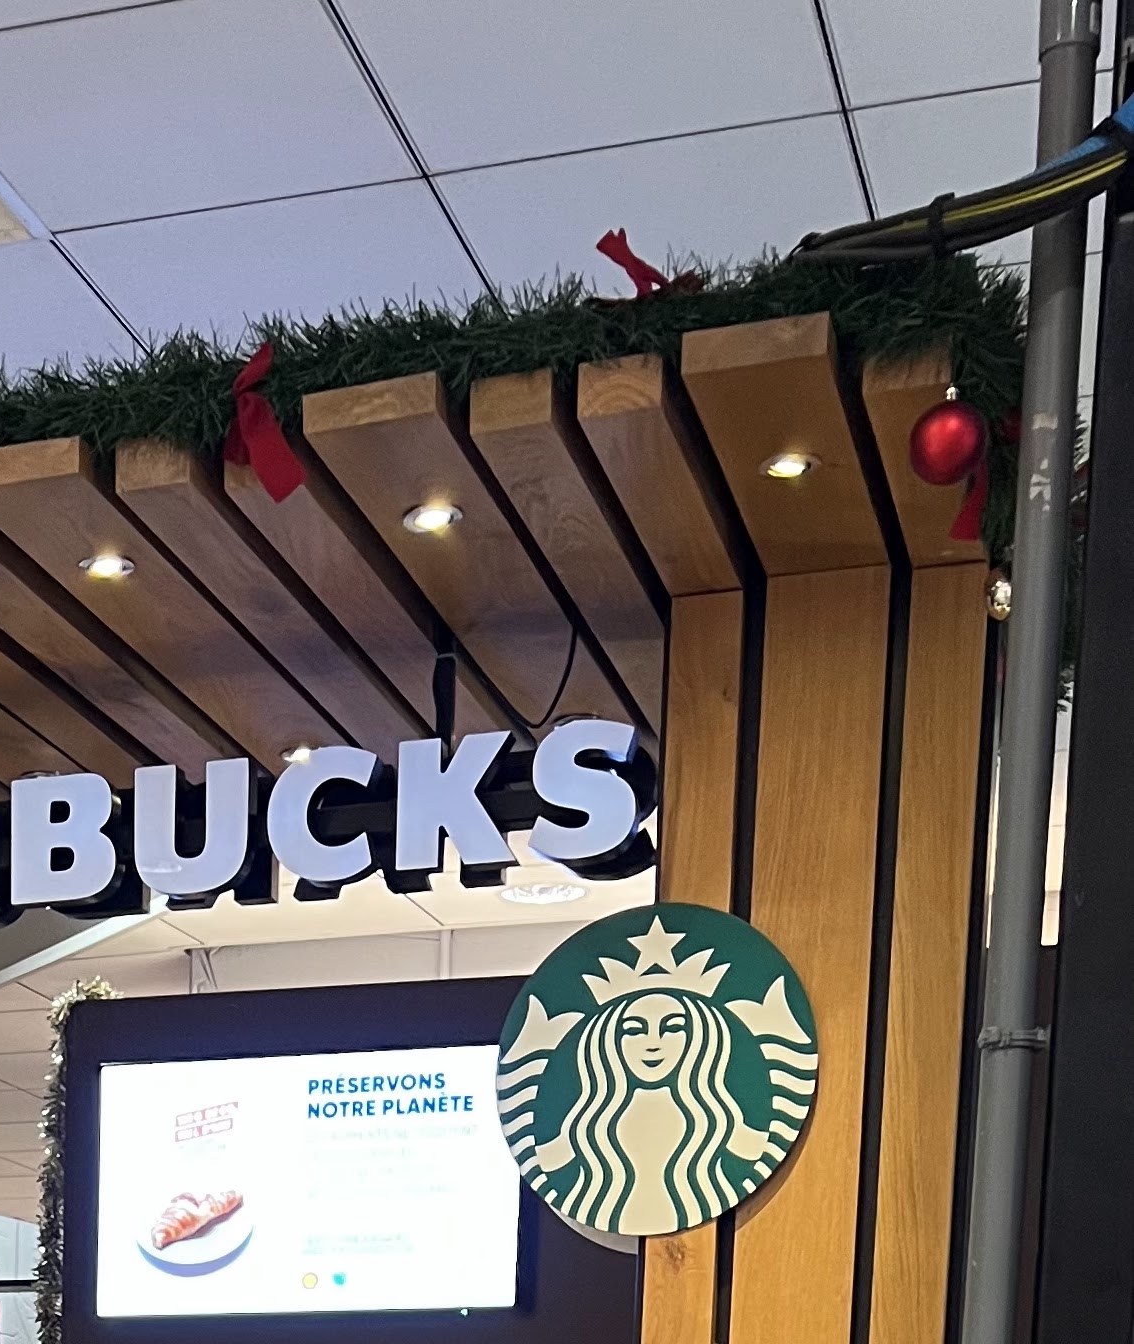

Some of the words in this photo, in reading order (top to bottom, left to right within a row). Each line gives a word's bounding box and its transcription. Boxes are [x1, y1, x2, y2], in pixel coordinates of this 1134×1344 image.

[308, 1072, 446, 1095] PRÉSERVONS
[307, 1099, 376, 1119] NOTRE
[382, 1092, 475, 1115] PLANÈTE
